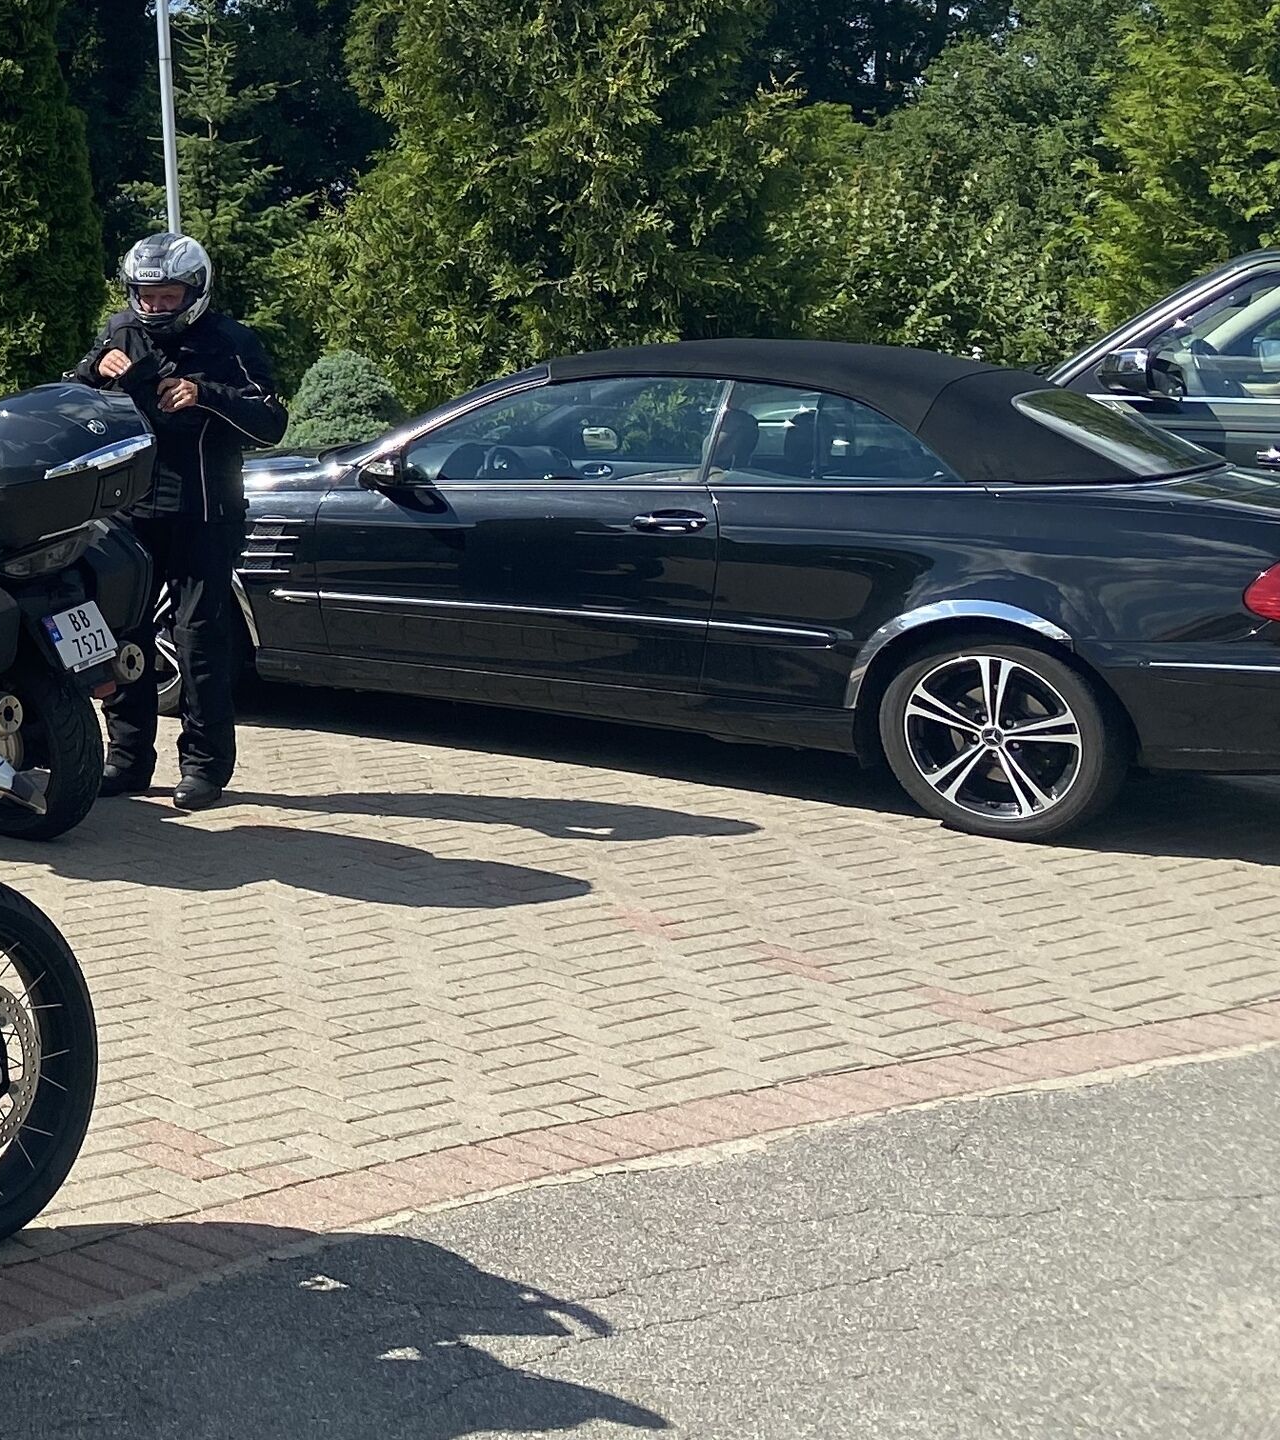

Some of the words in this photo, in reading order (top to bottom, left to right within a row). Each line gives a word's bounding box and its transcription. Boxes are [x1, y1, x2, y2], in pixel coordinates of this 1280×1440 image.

[139, 270, 161, 278] SHOEI
[68, 609, 91, 632] BB
[71, 628, 108, 659] 7527
